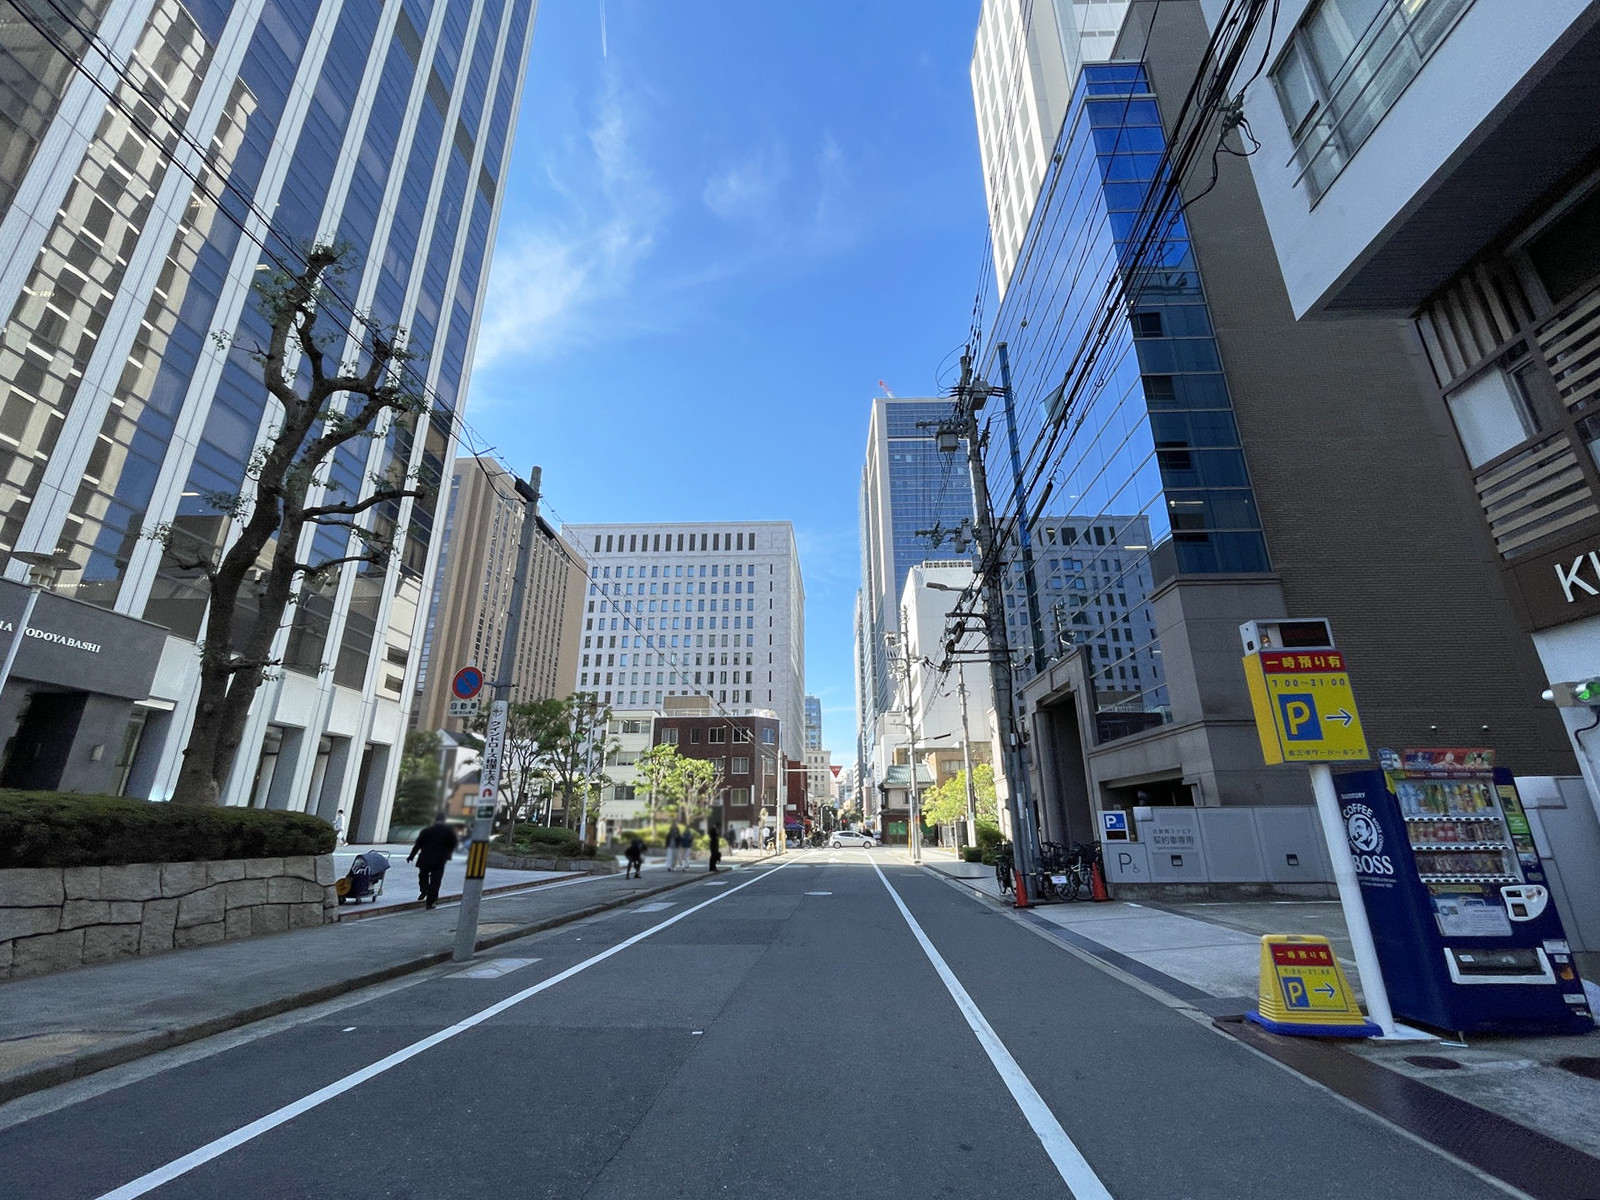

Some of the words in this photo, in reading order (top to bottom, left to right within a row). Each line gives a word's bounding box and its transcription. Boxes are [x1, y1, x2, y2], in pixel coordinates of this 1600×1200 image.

[24, 626, 102, 653] ODOYABASHI
[1266, 656, 1340, 668] 一時預り有
[1286, 701, 1311, 736] P
[1342, 803, 1374, 819] COFFEE
[1105, 815, 1117, 829] P
[1118, 852, 1133, 874] P
[1351, 854, 1395, 875] BOSS
[1288, 981, 1303, 1004] P
